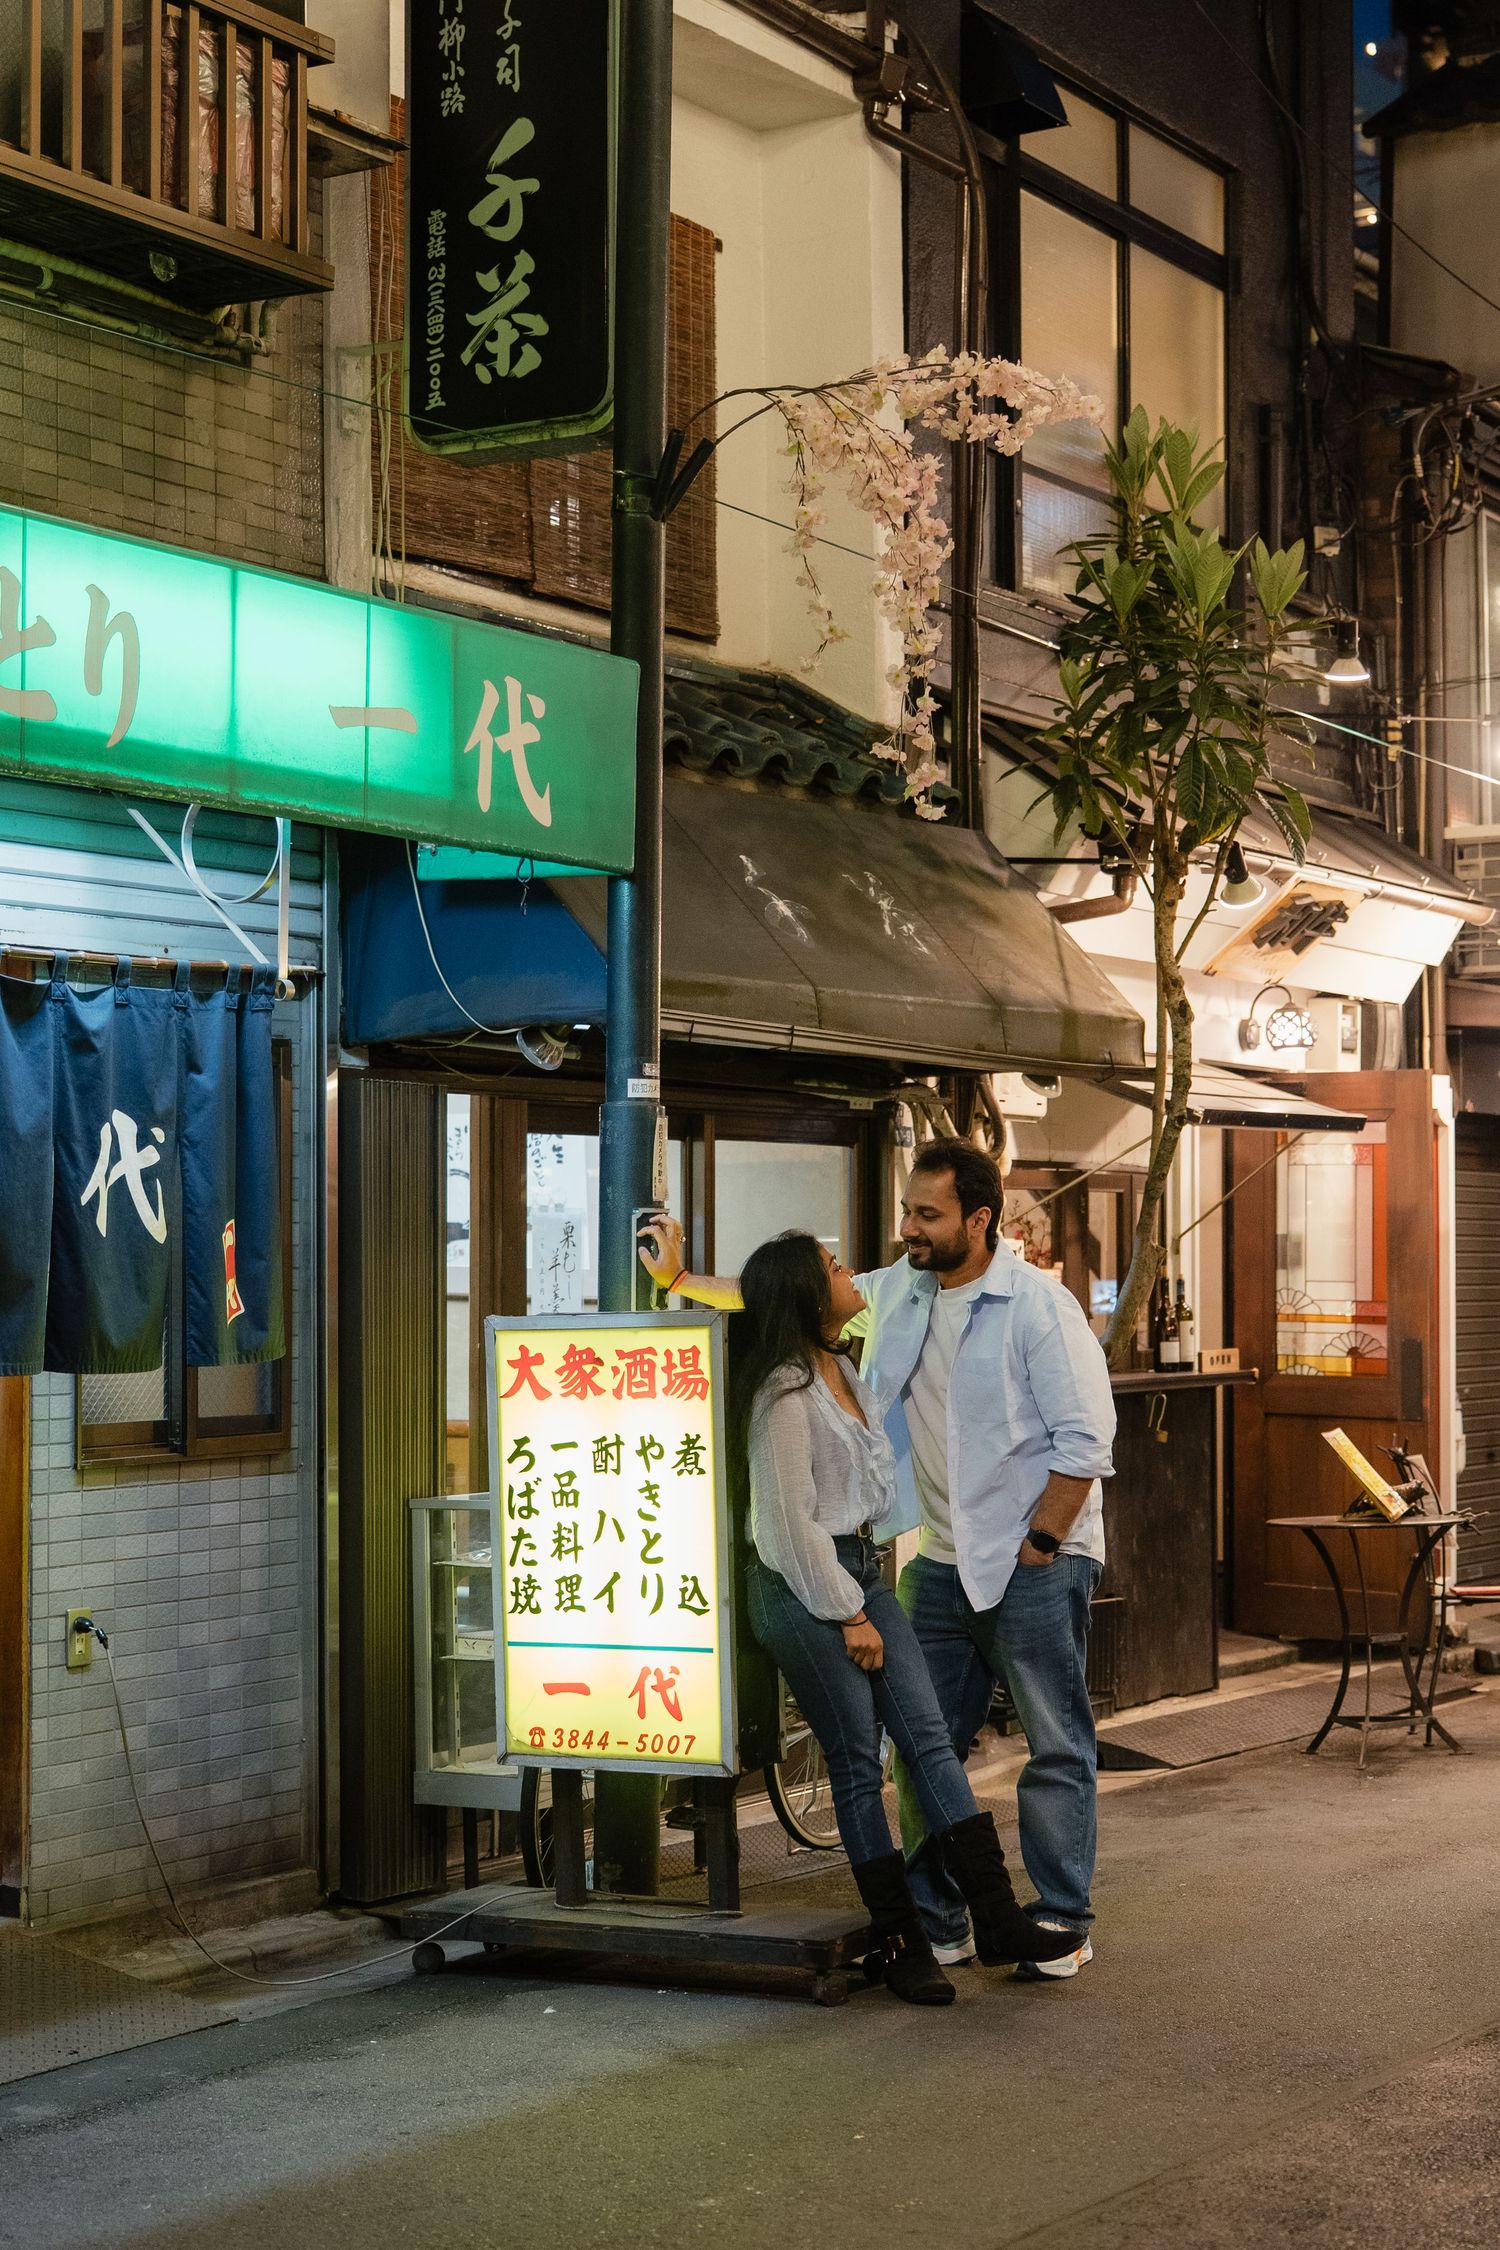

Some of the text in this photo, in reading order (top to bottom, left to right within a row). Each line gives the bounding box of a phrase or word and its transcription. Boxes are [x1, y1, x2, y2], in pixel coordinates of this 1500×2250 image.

[439, 0, 466, 118] 柳小路
[427, 209, 447, 260] 電話
[329, 675, 552, 827] 一代
[80, 1109, 168, 1244] 代
[500, 1343, 711, 1402] 大衆酒場
[1210, 1355, 1231, 1366] OPEN
[507, 1434, 543, 1616] ろばた焼
[550, 1440, 586, 1614] 一品料理
[592, 1433, 626, 1614] 酎ハイ
[635, 1433, 665, 1617] やきとり
[671, 1432, 711, 1616] 煮込
[542, 1665, 684, 1723] 一代
[552, 1727, 697, 1756] 3844-5007
